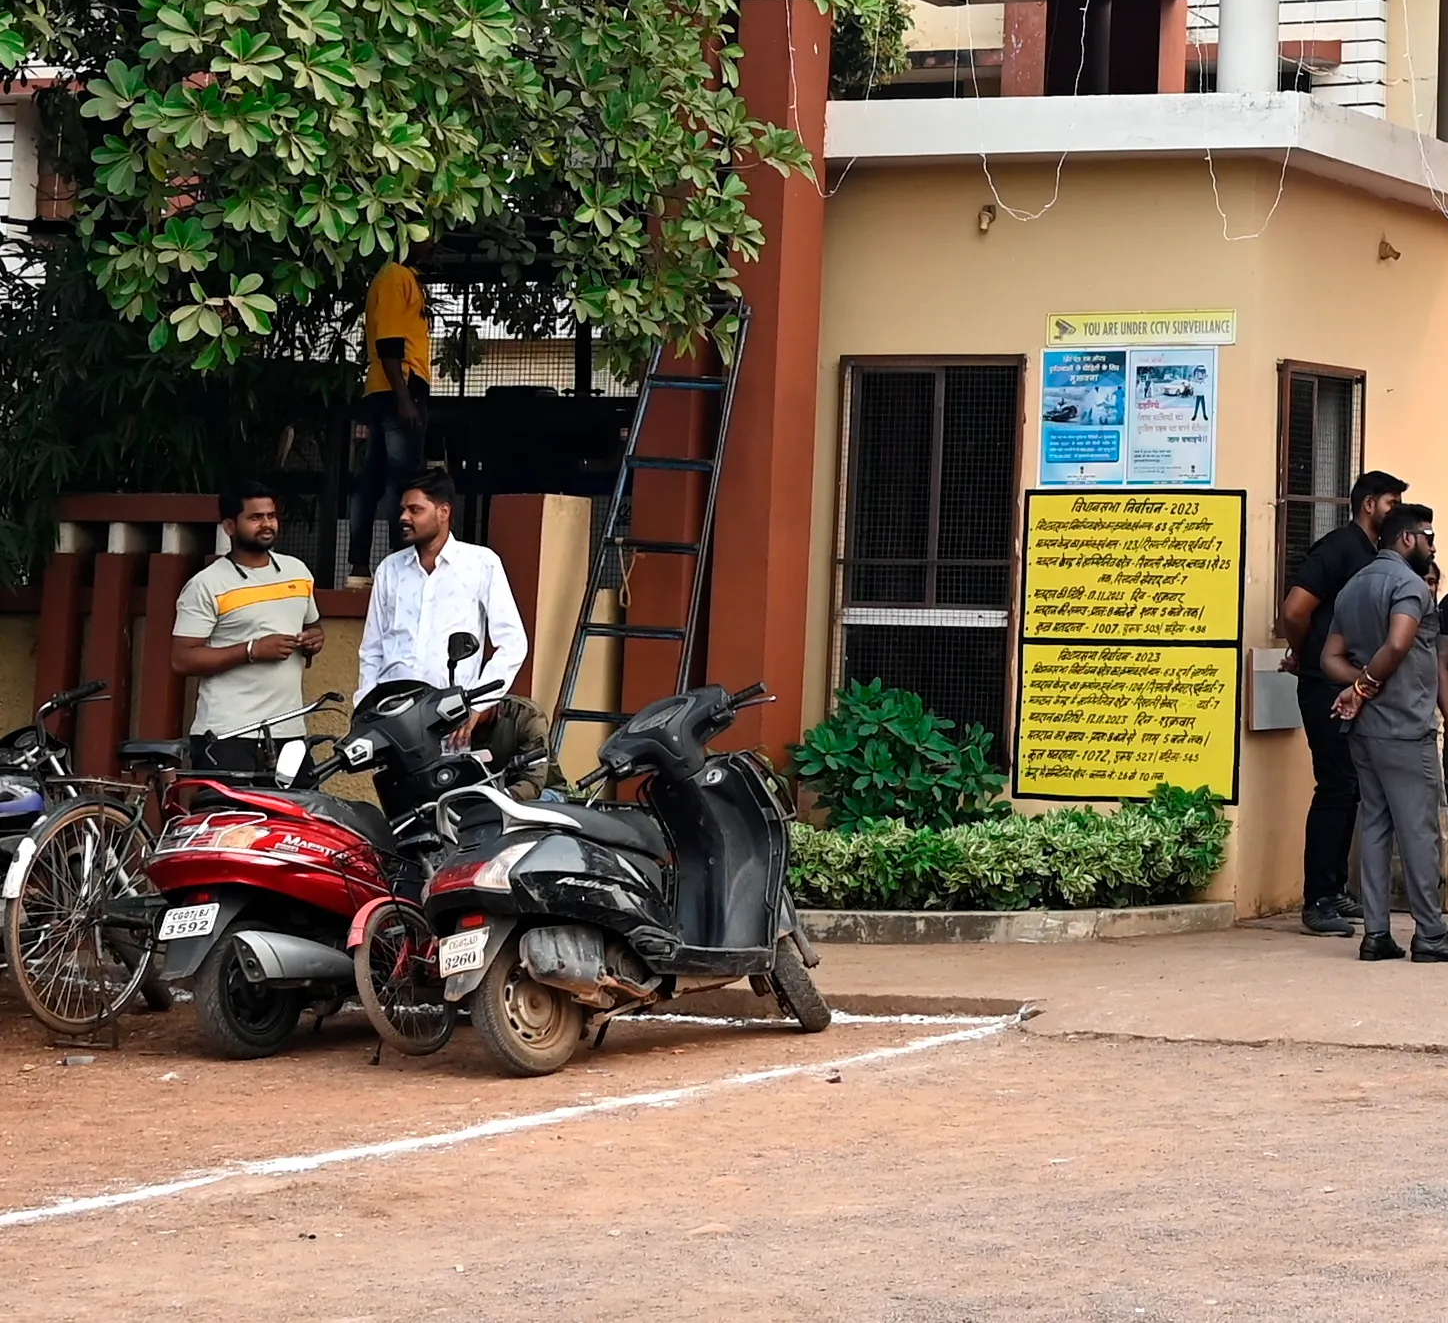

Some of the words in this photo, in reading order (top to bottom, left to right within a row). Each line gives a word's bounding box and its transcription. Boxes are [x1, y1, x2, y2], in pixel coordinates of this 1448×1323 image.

[1083, 322, 1100, 336] YOU
[1102, 322, 1118, 336] ARE
[1120, 321, 1148, 335] UNDER
[1150, 320, 1171, 334] CCTV
[1172, 320, 1231, 334] SURVEILLANCE
[1071, 497, 1121, 513] विधानसभा
[1123, 497, 1166, 514] निर्वाचन
[1170, 502, 1200, 515] 2023
[1219, 559, 1231, 569] 25
[1160, 607, 1168, 617] 5
[1057, 648, 1099, 661] विधानसभा
[1098, 647, 1131, 662] निर्वाचन
[1135, 652, 1161, 663] 2023
[1133, 711, 1154, 726] दिन
[1159, 716, 1196, 730] शुक्रवार
[1162, 733, 1170, 744] 5
[165, 920, 209, 935] 3592
[445, 951, 477, 971] 3260
